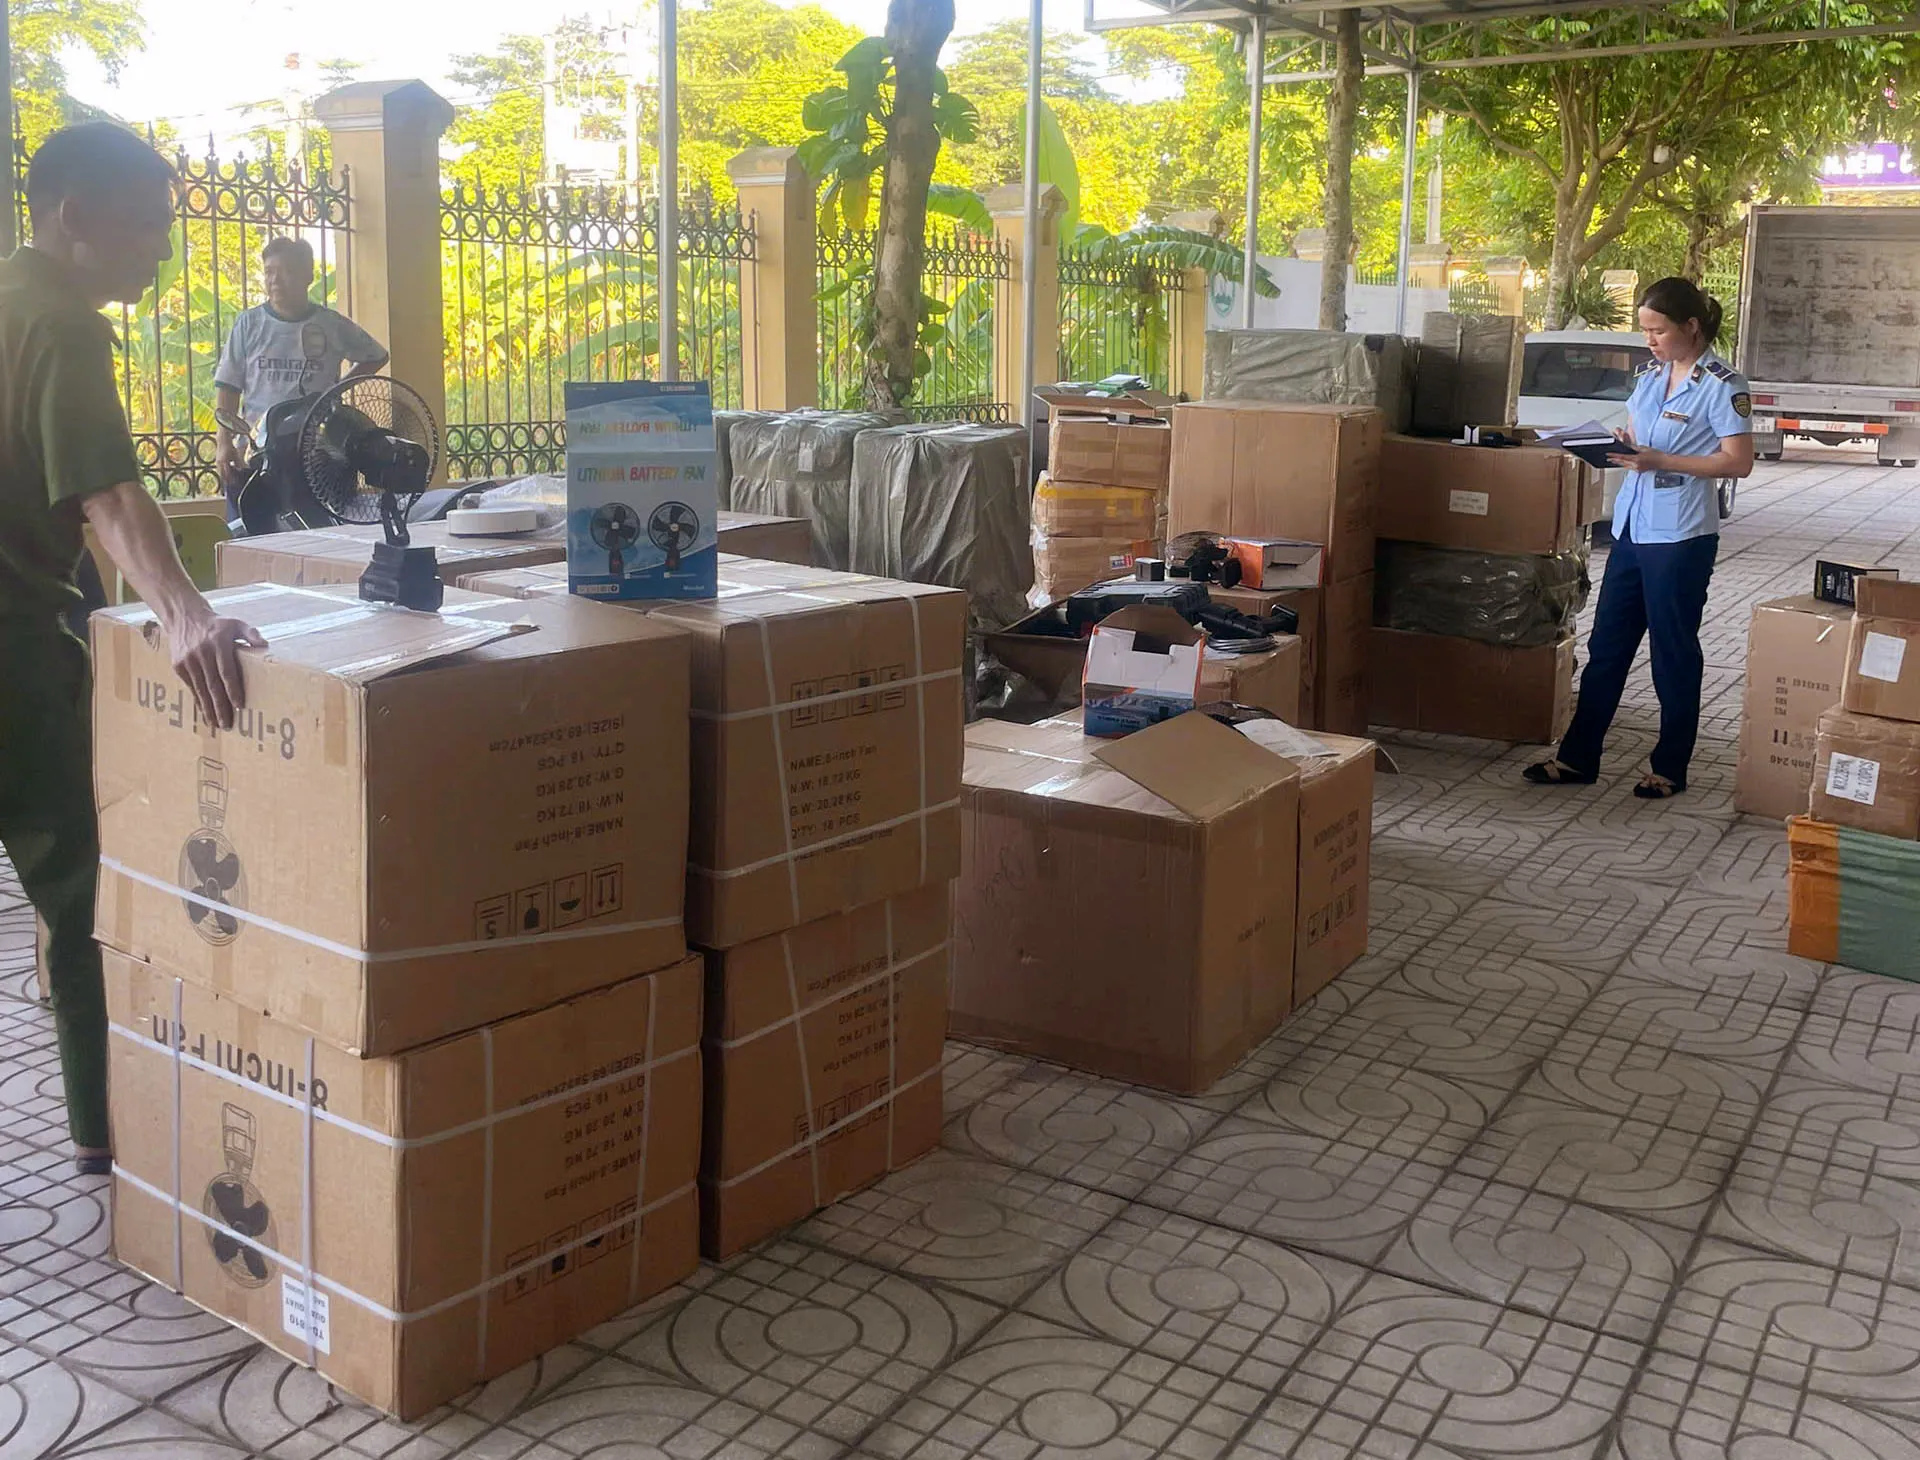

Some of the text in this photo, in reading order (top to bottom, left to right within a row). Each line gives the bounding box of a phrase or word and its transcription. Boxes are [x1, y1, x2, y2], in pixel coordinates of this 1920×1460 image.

[1823, 422, 1846, 431] STOP
[576, 465, 706, 483] LITHIUM BATTERY FAN
[137, 677, 296, 761] 8-ini Fan
[537, 754, 566, 771] PCS
[846, 768, 861, 781] KG
[536, 782, 556, 798] KG
[846, 790, 862, 804] KG
[537, 807, 557, 823] KG
